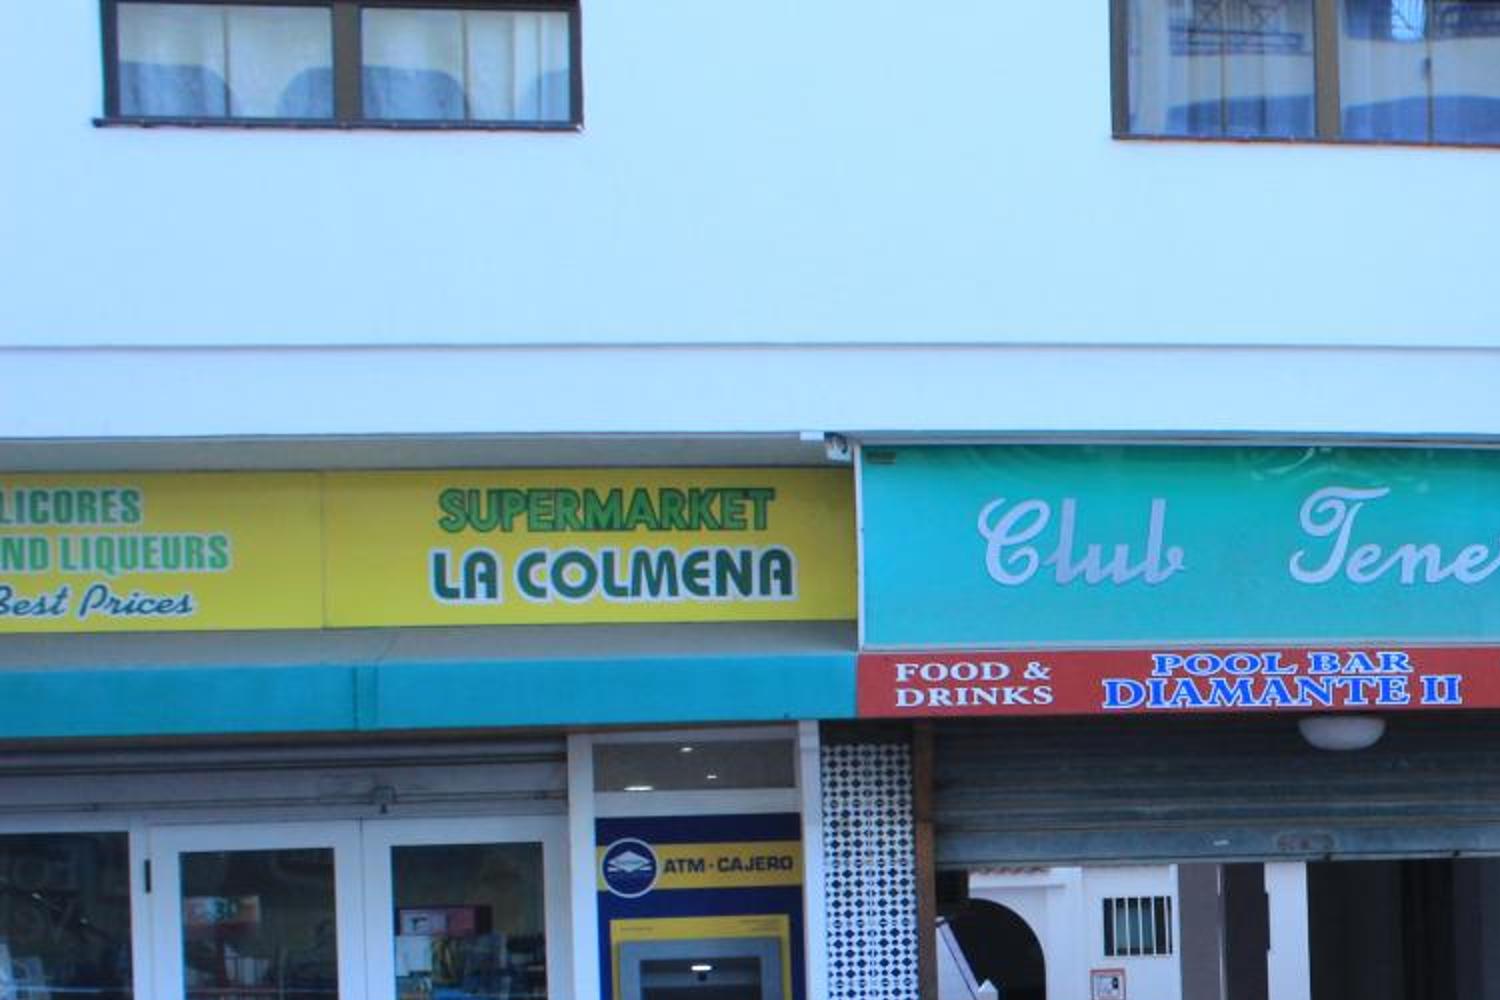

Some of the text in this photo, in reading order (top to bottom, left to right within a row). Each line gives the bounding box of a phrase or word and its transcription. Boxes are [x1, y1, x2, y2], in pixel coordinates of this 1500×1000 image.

[0, 489, 141, 525] LICORES
[438, 486, 777, 532] SUPERMARKET
[61, 534, 229, 576] LIQUEURS
[977, 497, 1185, 586] Club
[432, 549, 794, 599] LA COLMENA
[79, 584, 194, 618] Prices
[895, 661, 1052, 683] FOOD &
[1151, 650, 1416, 678] POOL BAR
[895, 685, 1054, 708] DRINKS
[1102, 673, 1464, 710] DIAMANTE II
[662, 855, 794, 874] ATM CAJERO
